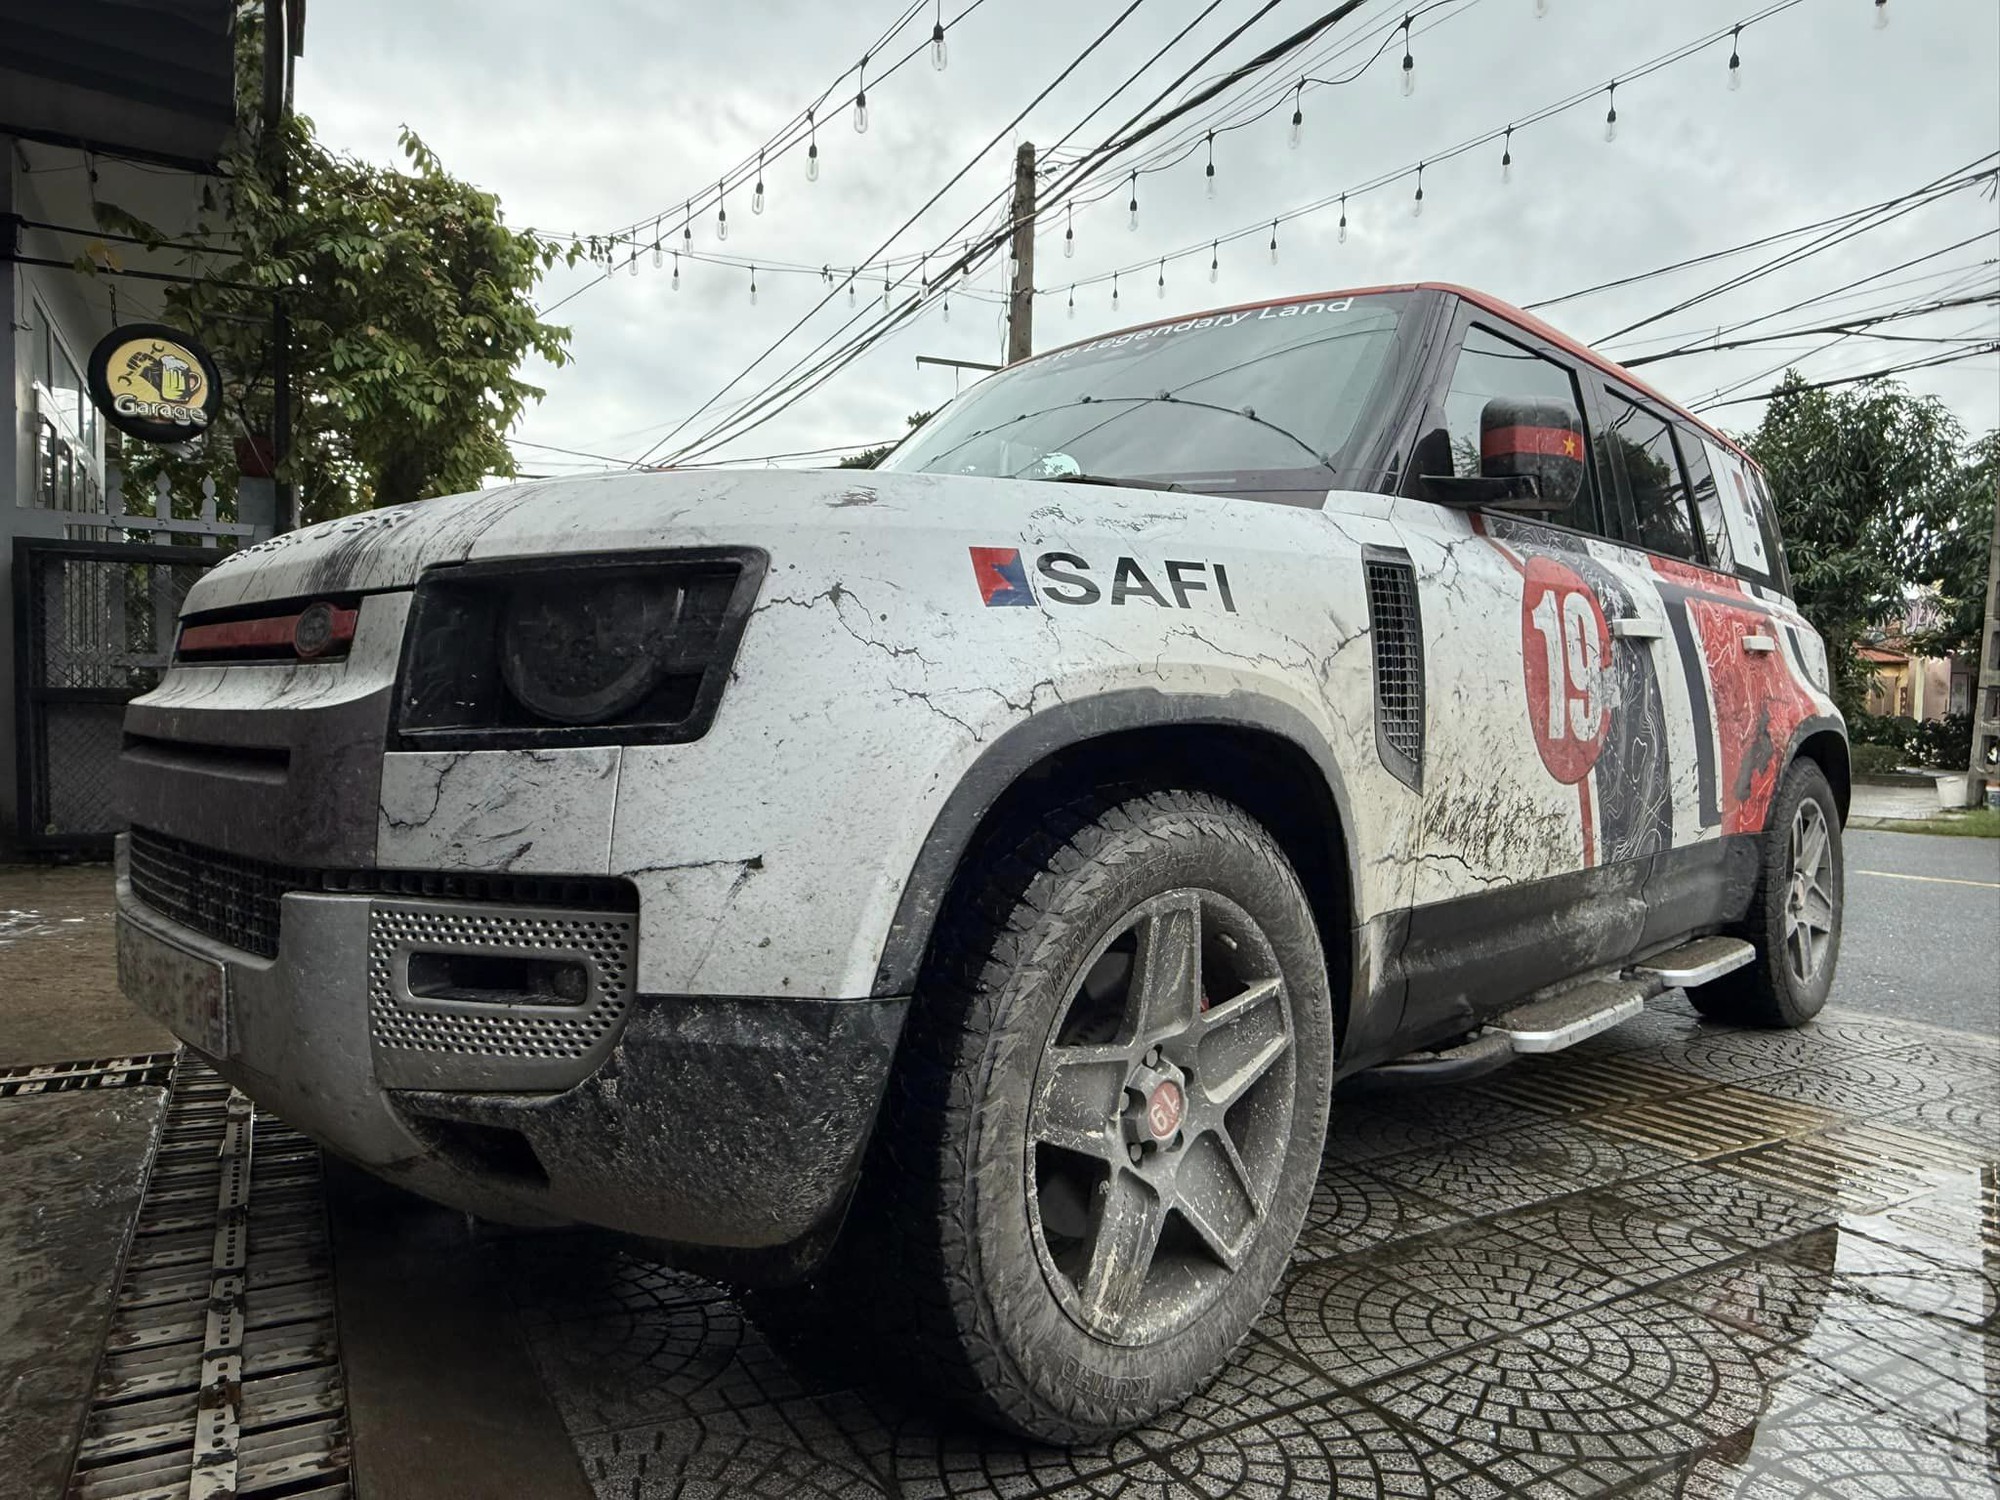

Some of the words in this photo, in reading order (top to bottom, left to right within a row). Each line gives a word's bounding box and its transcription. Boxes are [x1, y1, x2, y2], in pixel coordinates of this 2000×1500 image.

[1086, 311, 1251, 352] Legendary
[1259, 297, 1354, 320] Land
[113, 393, 209, 428] Garage
[1036, 551, 1236, 613] SAFI
[1531, 589, 1603, 742] 19
[1150, 1089, 1181, 1132] 19
